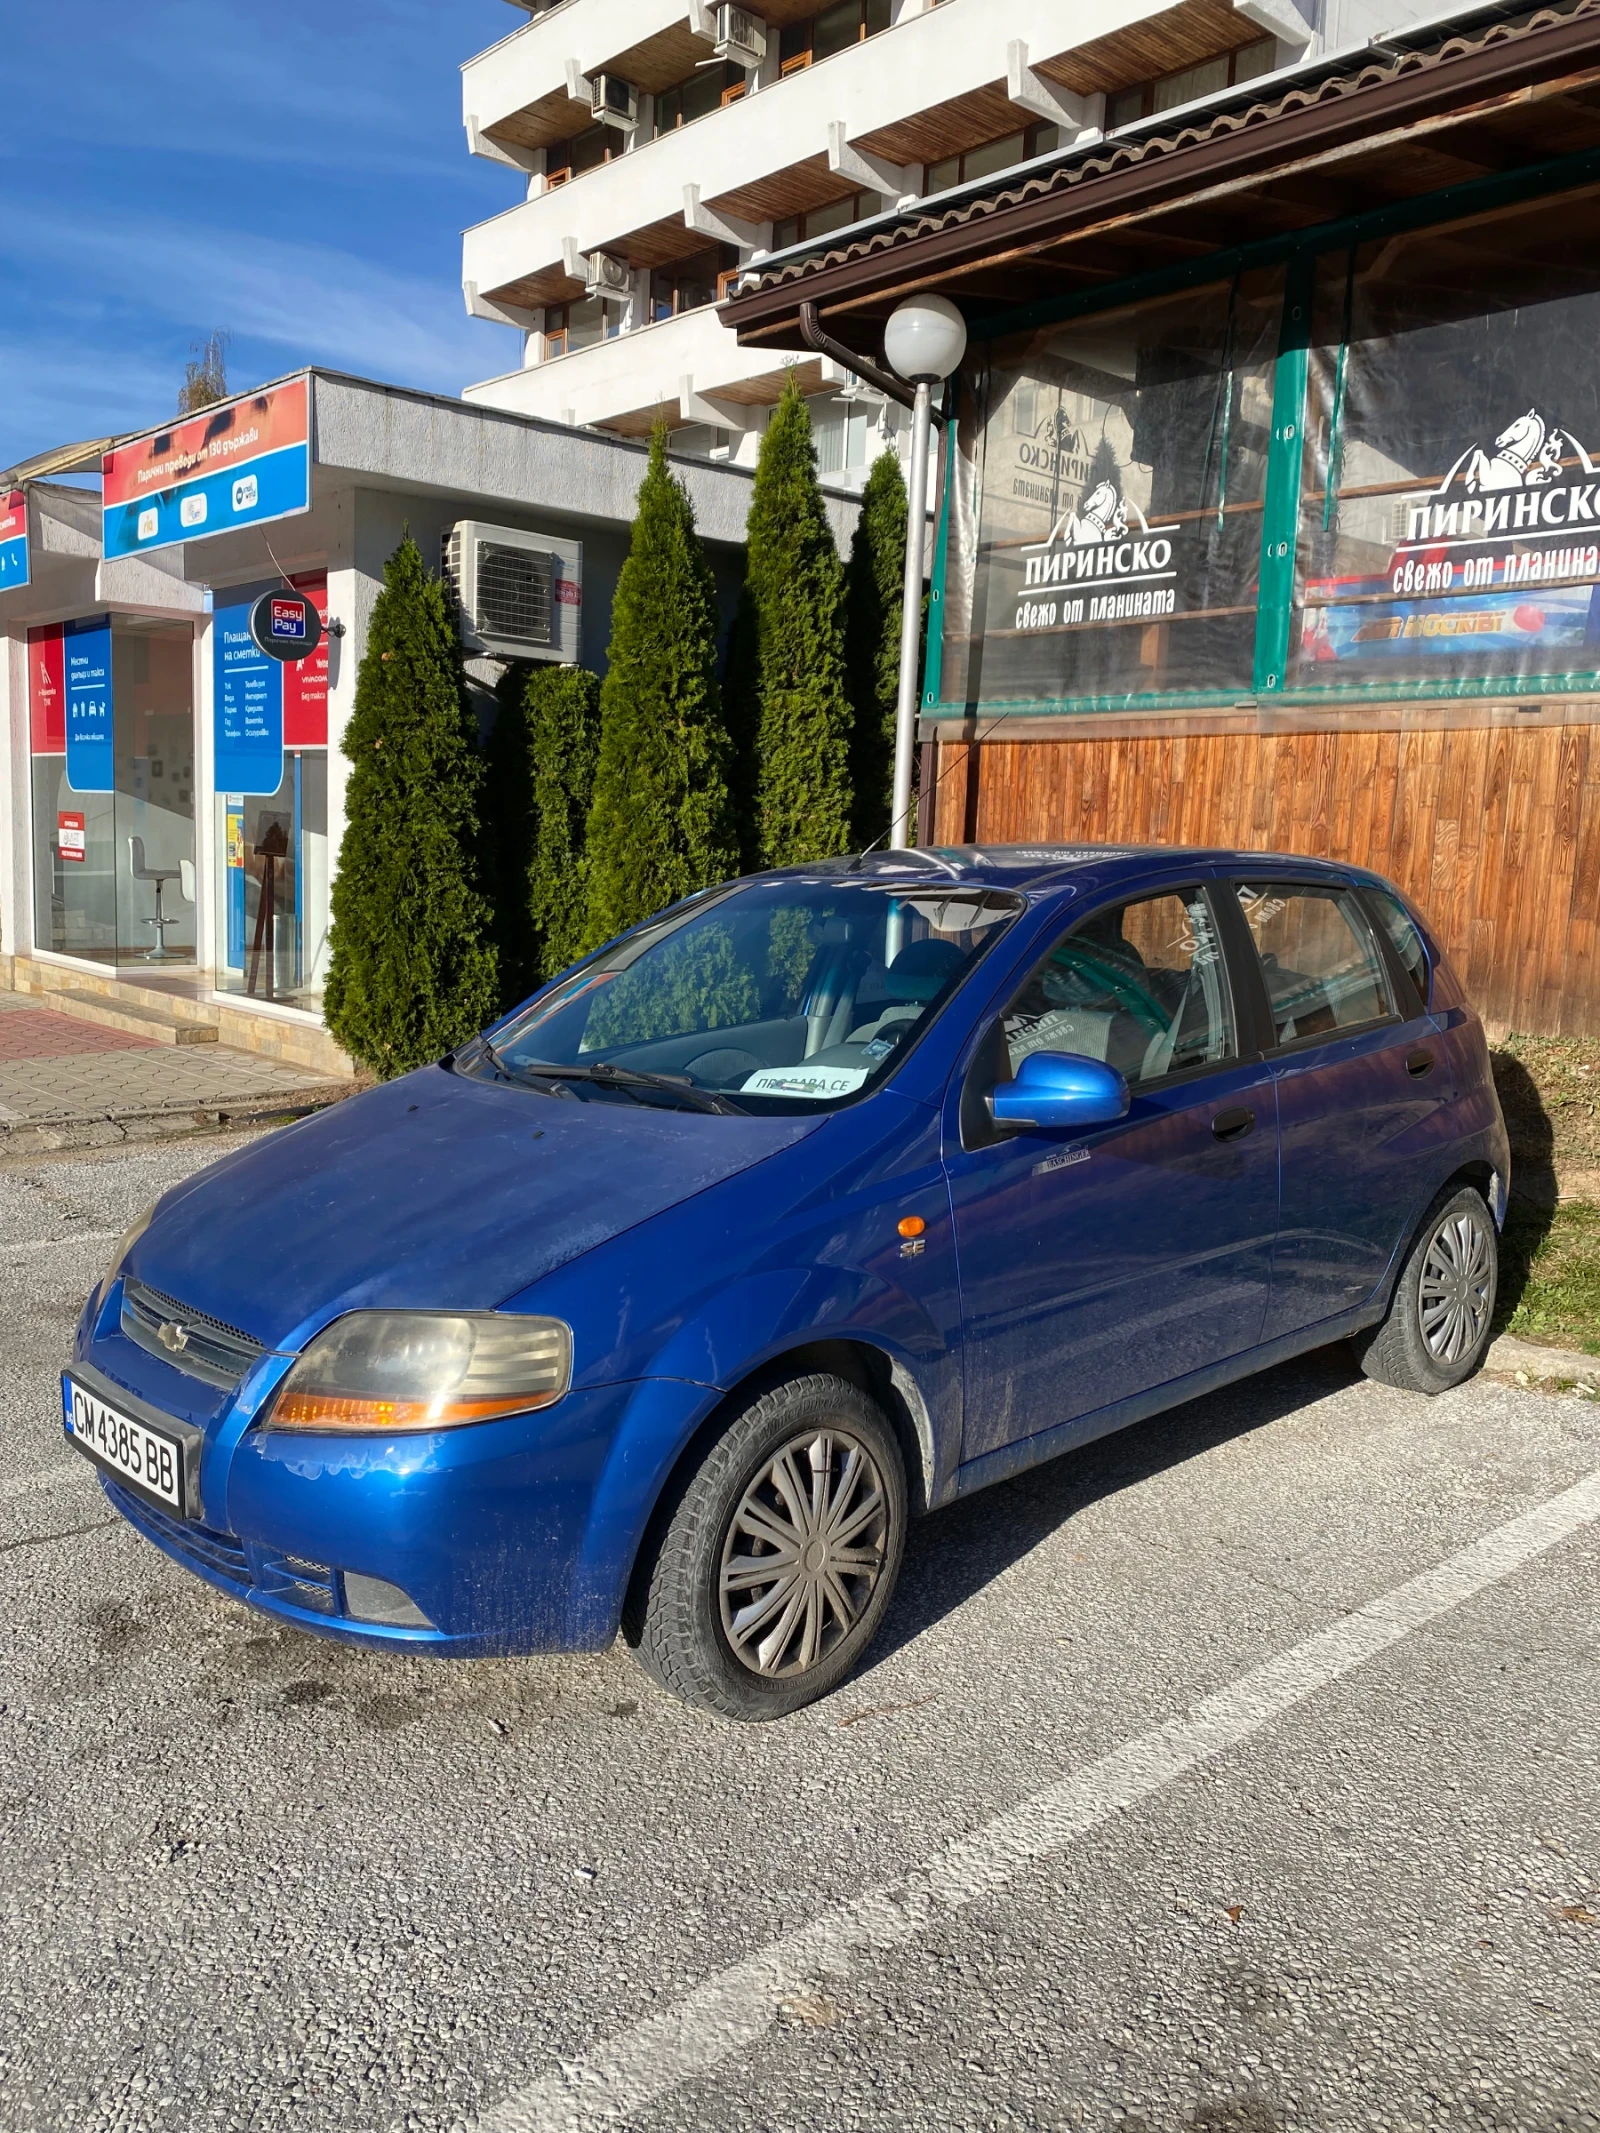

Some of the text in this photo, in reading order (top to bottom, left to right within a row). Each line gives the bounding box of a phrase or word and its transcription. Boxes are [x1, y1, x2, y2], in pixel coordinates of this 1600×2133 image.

[197, 448, 208, 462] от
[208, 439, 221, 458] 130
[222, 427, 259, 455] държави
[1407, 484, 1600, 541] ПИРИНСК
[1025, 539, 1172, 585] ПИРИНСКО
[1393, 545, 1600, 594] свежо от планина
[274, 606, 302, 621] Easy
[1016, 588, 1175, 629] свежо от планината
[274, 619, 297, 634] Pay
[224, 649, 233, 661] на
[829, 1080, 851, 1092] СЕ
[900, 1239, 926, 1259] SE
[74, 1391, 174, 1494] CM 4385 BB
